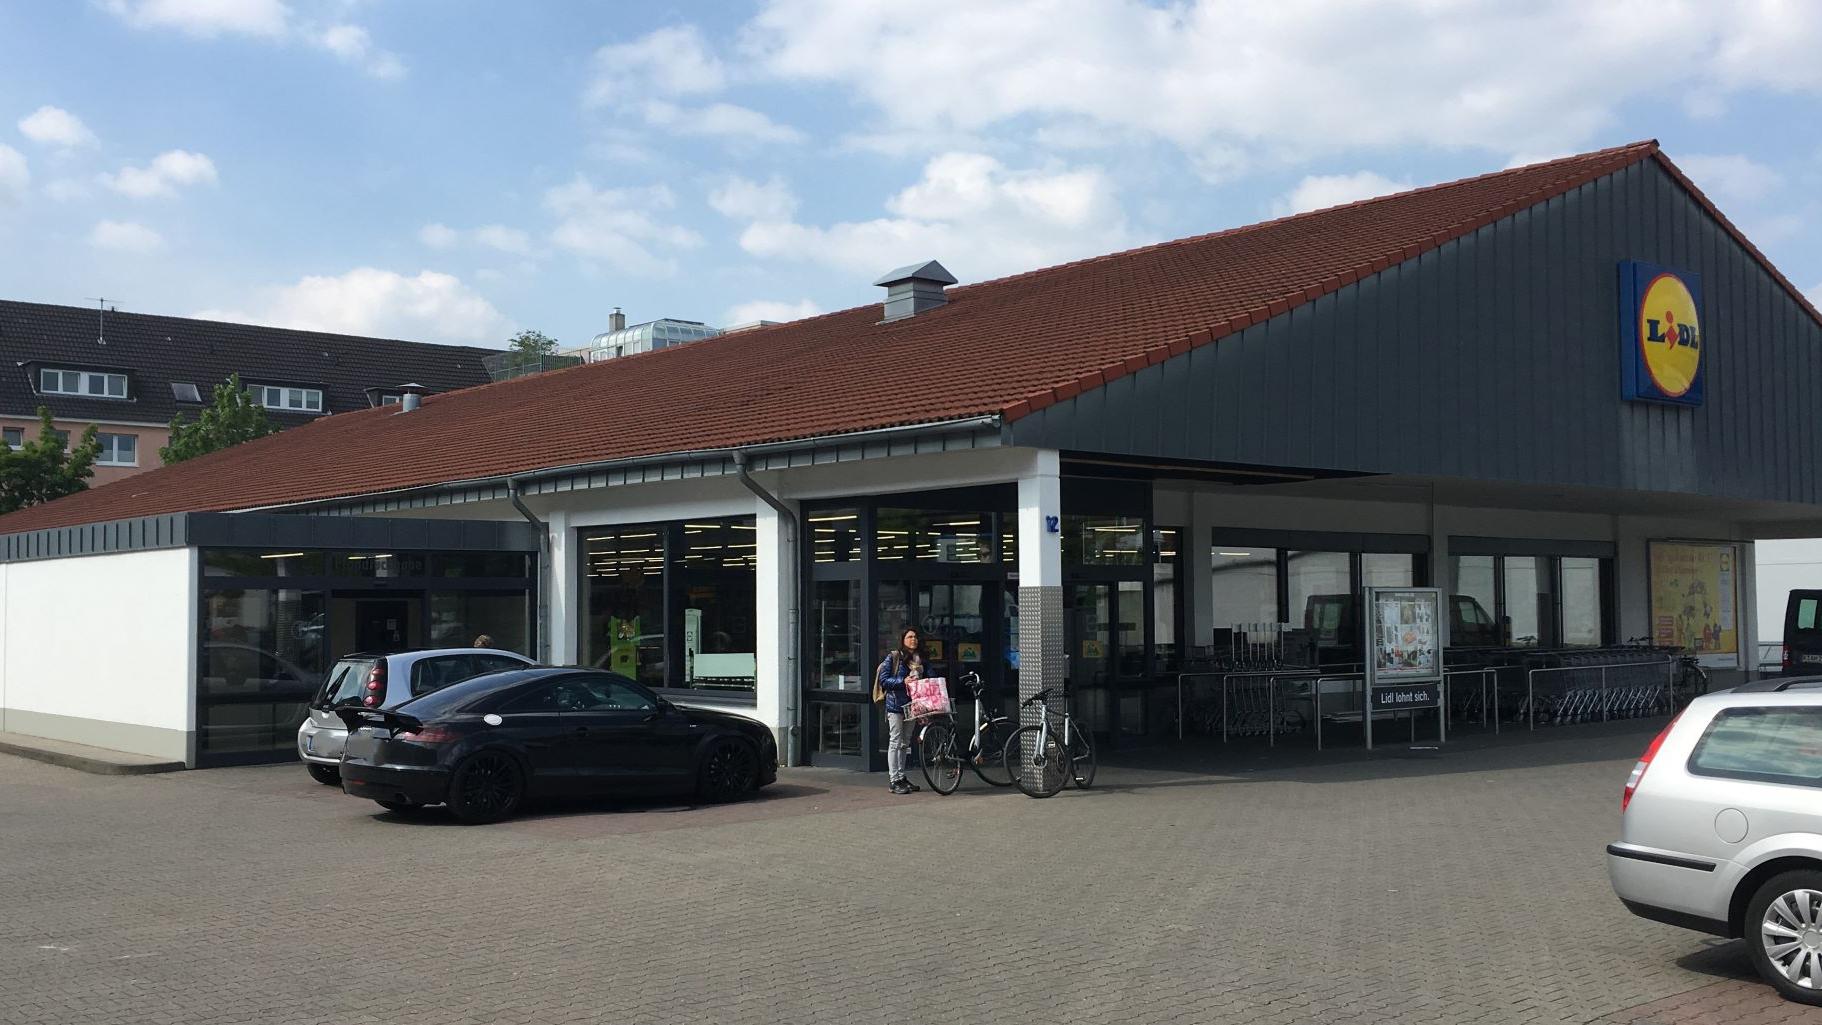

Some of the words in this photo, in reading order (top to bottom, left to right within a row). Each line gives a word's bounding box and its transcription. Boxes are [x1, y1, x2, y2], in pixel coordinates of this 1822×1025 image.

[1381, 692, 1394, 704] Lidl
[1395, 691, 1413, 702] lohnt
[1414, 690, 1430, 702] sich.
